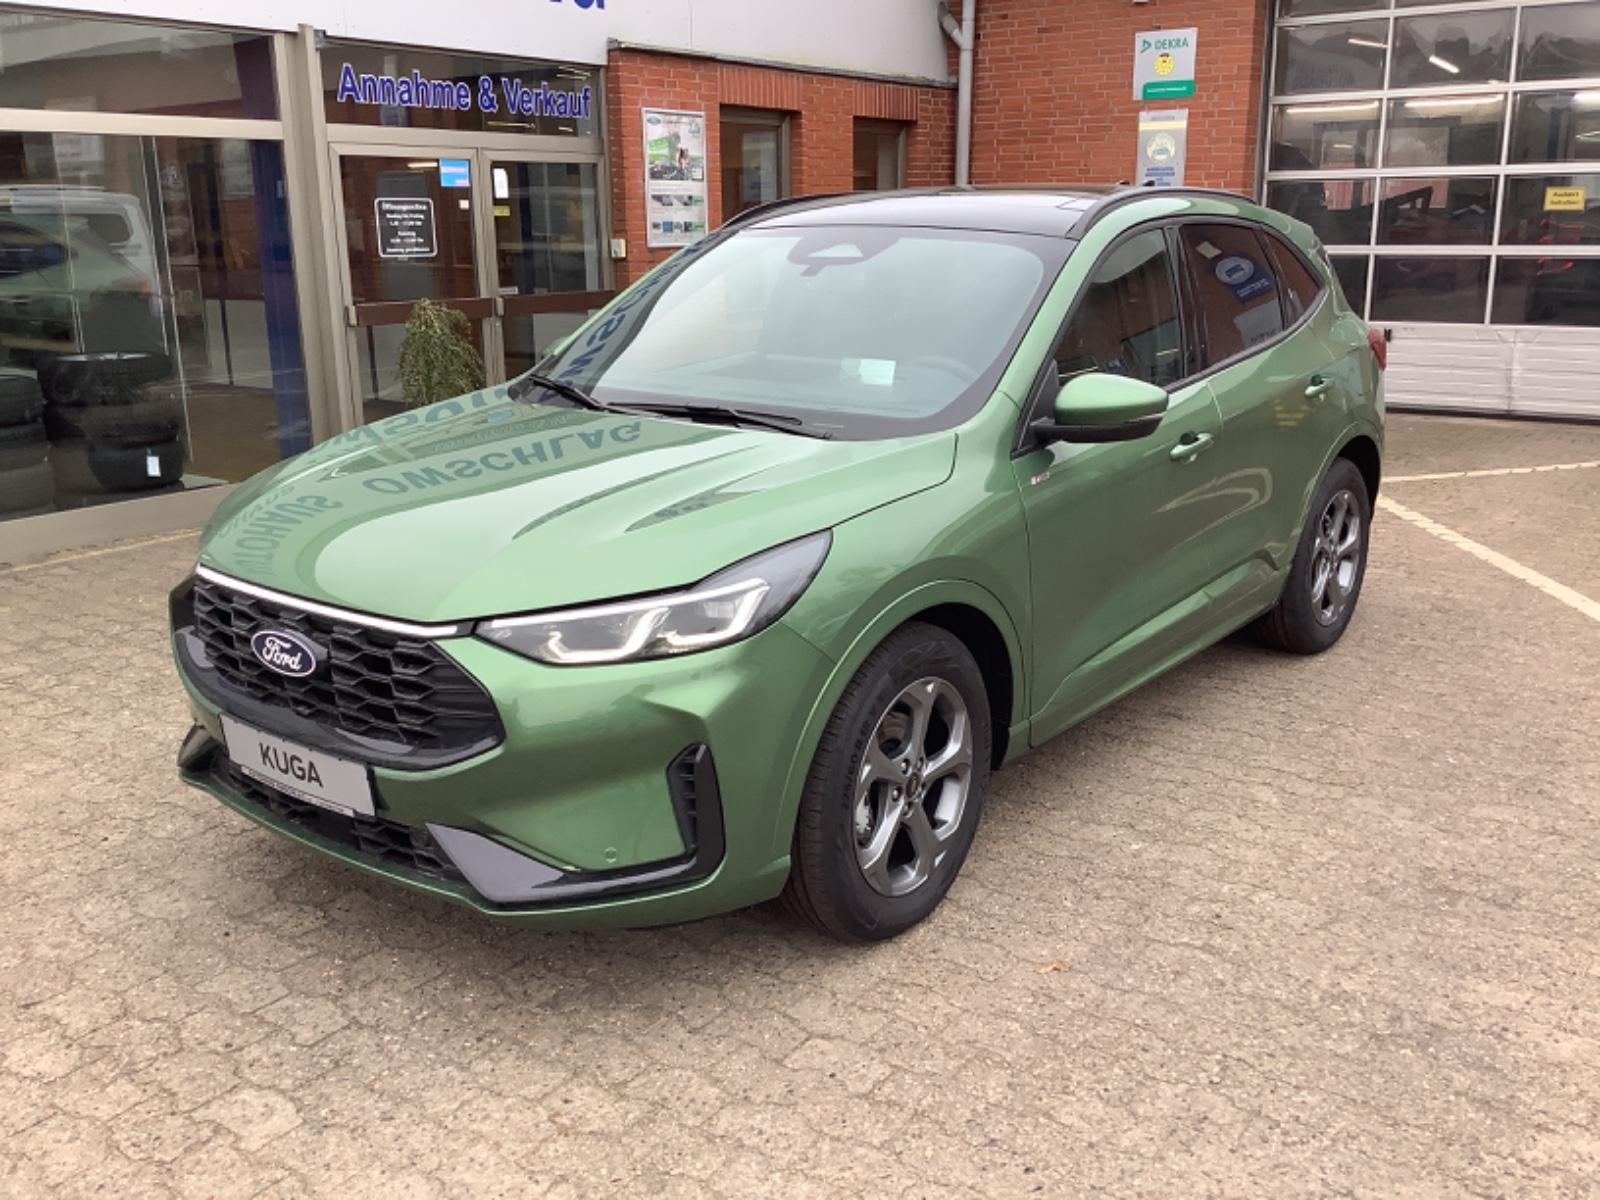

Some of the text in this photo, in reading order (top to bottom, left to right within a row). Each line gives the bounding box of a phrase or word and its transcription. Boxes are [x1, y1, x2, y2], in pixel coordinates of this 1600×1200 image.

[337, 63, 592, 119] Annahme & Verkauf
[262, 635, 303, 671] Ford
[258, 742, 325, 789] KUGA
